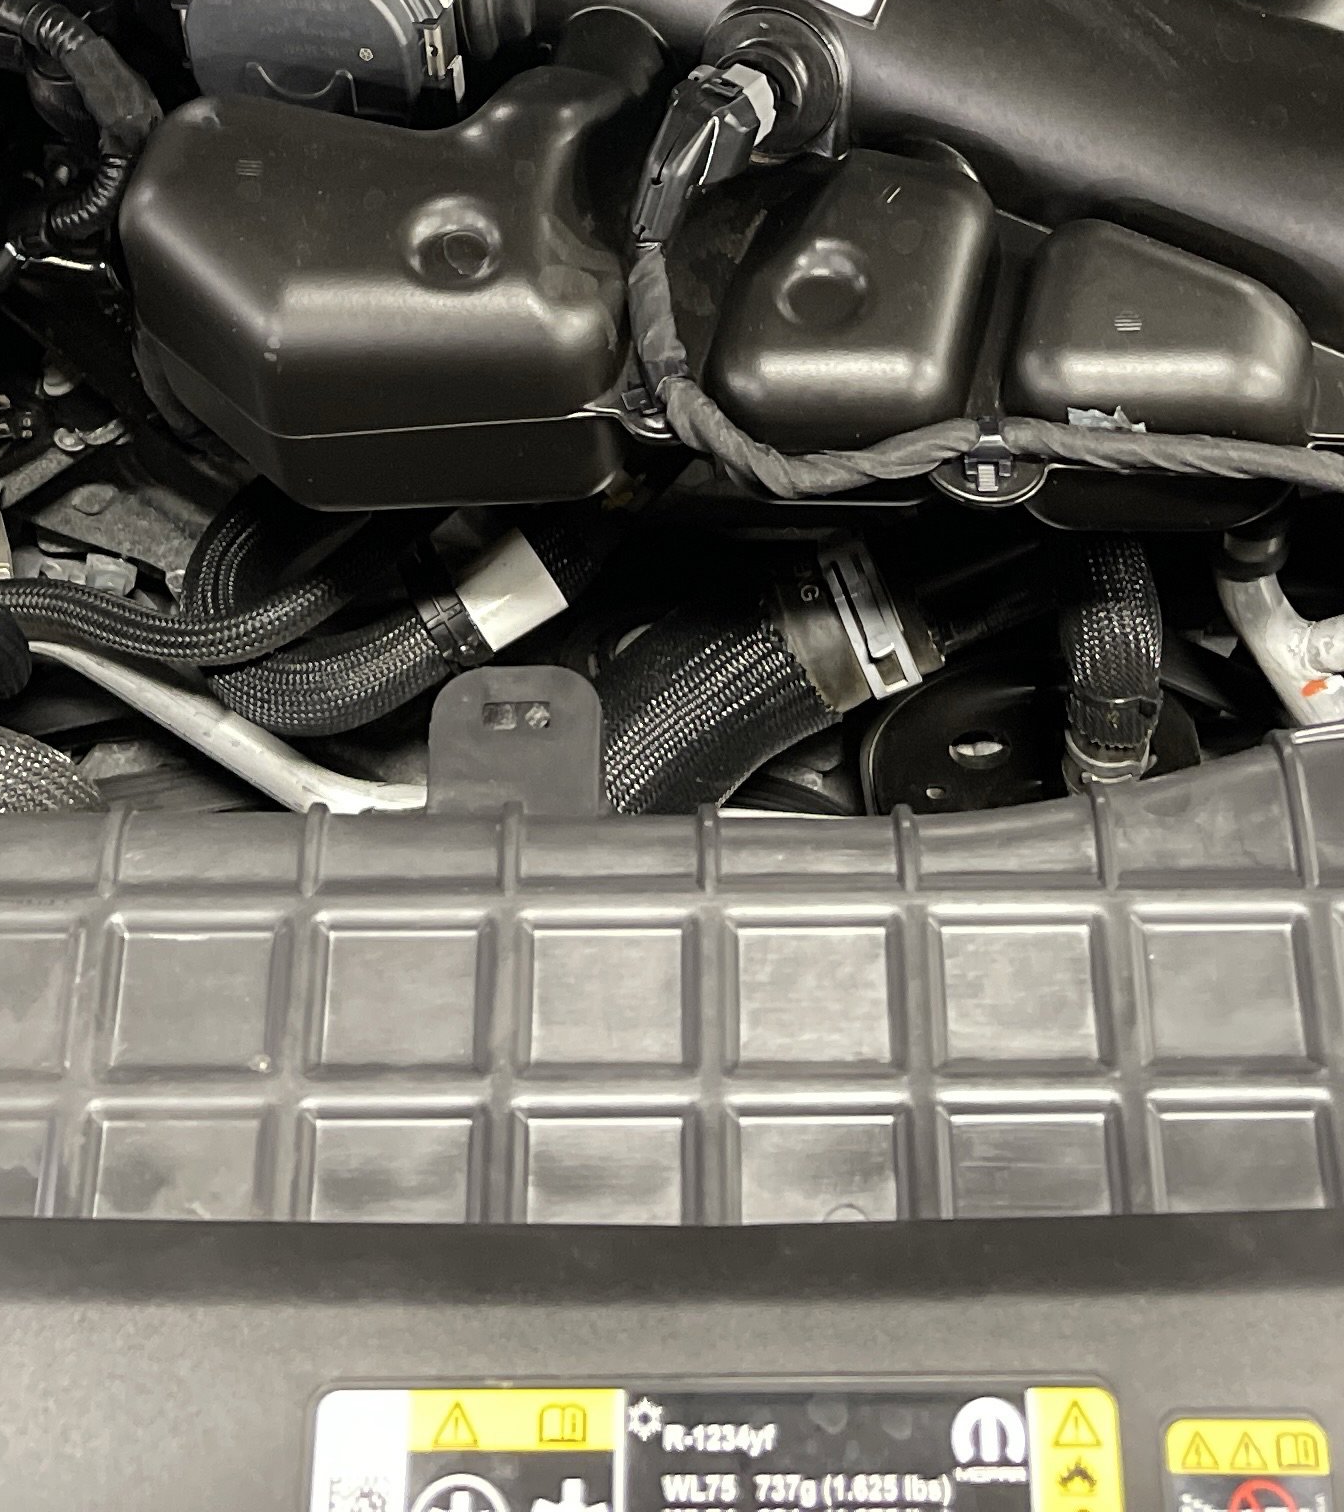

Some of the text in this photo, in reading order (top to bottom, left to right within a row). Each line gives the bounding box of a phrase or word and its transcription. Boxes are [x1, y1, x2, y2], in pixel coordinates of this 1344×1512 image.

[662, 1423, 777, 1457] R-1234yf
[661, 1473, 952, 1508] WL75 737g (1.625 lbs)
